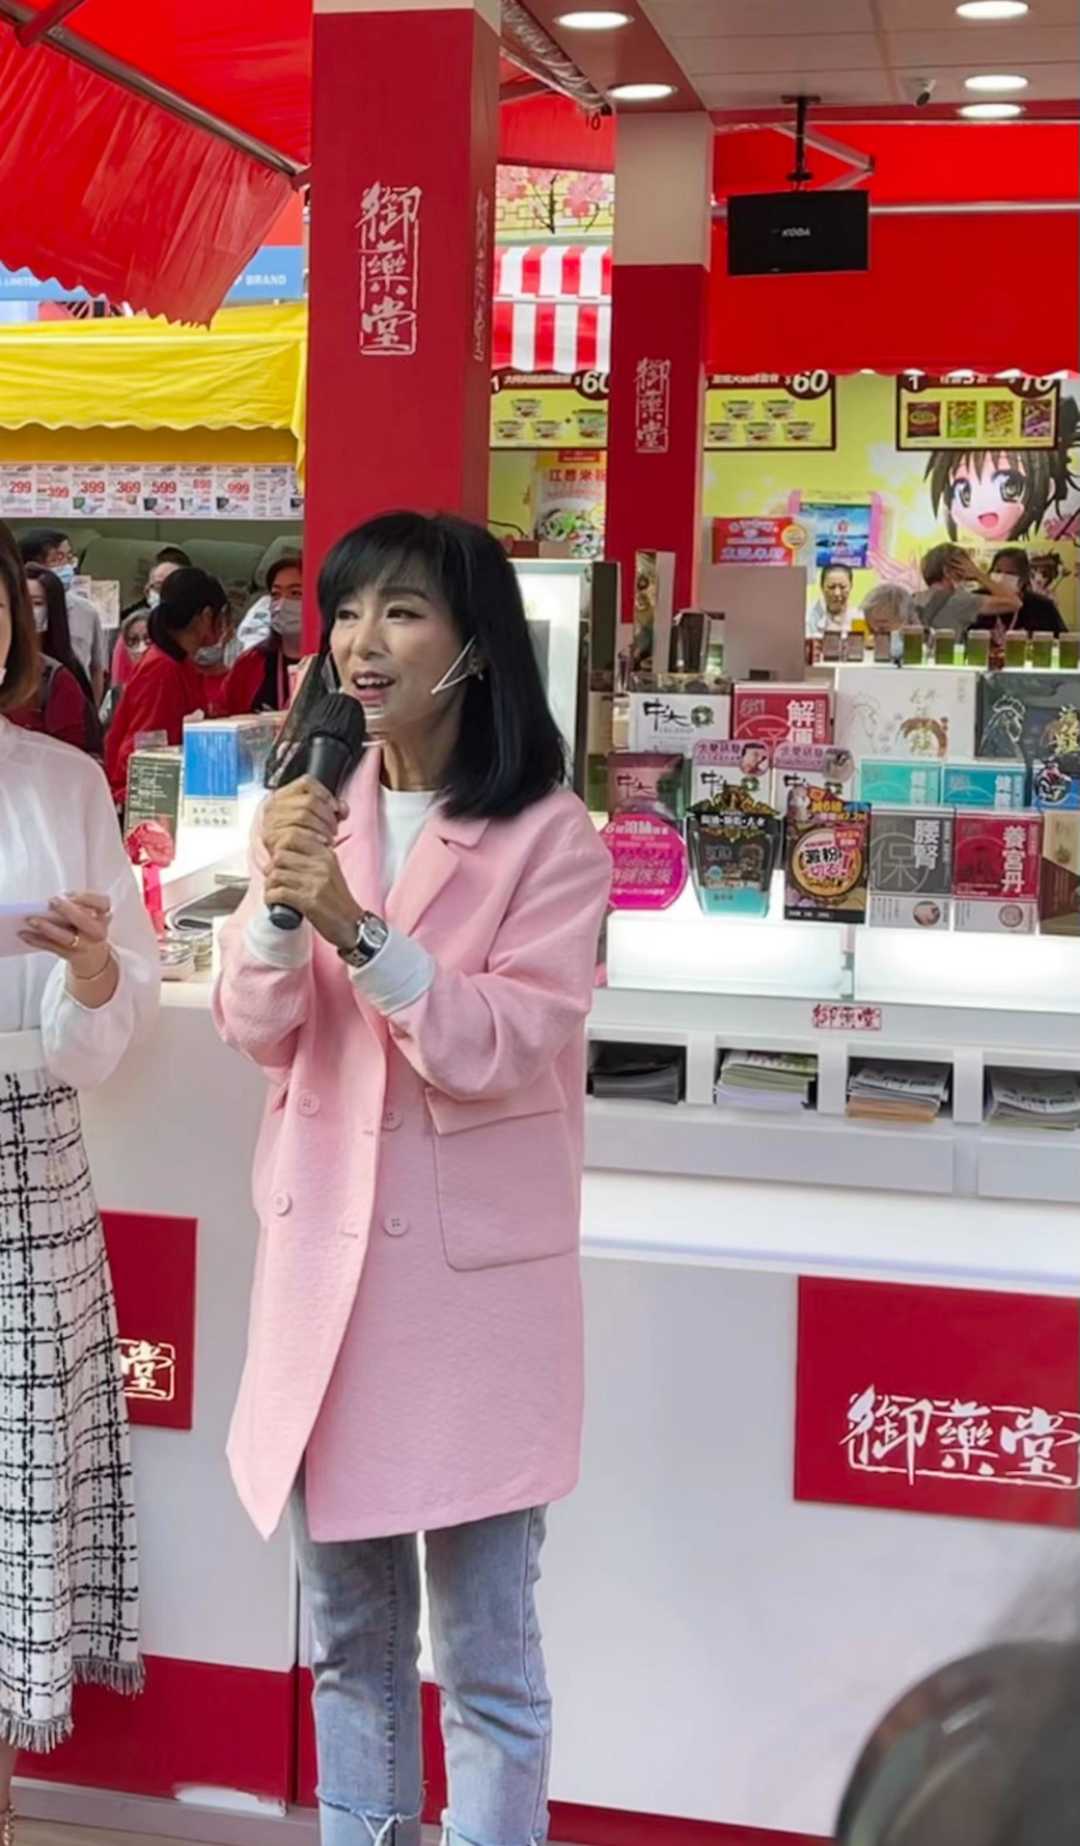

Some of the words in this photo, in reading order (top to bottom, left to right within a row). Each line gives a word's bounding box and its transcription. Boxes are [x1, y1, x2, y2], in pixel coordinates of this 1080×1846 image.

[245, 274, 288, 286] BRAND
[9, 480, 32, 494] 299
[80, 480, 105, 494] 399
[151, 480, 177, 494] 599
